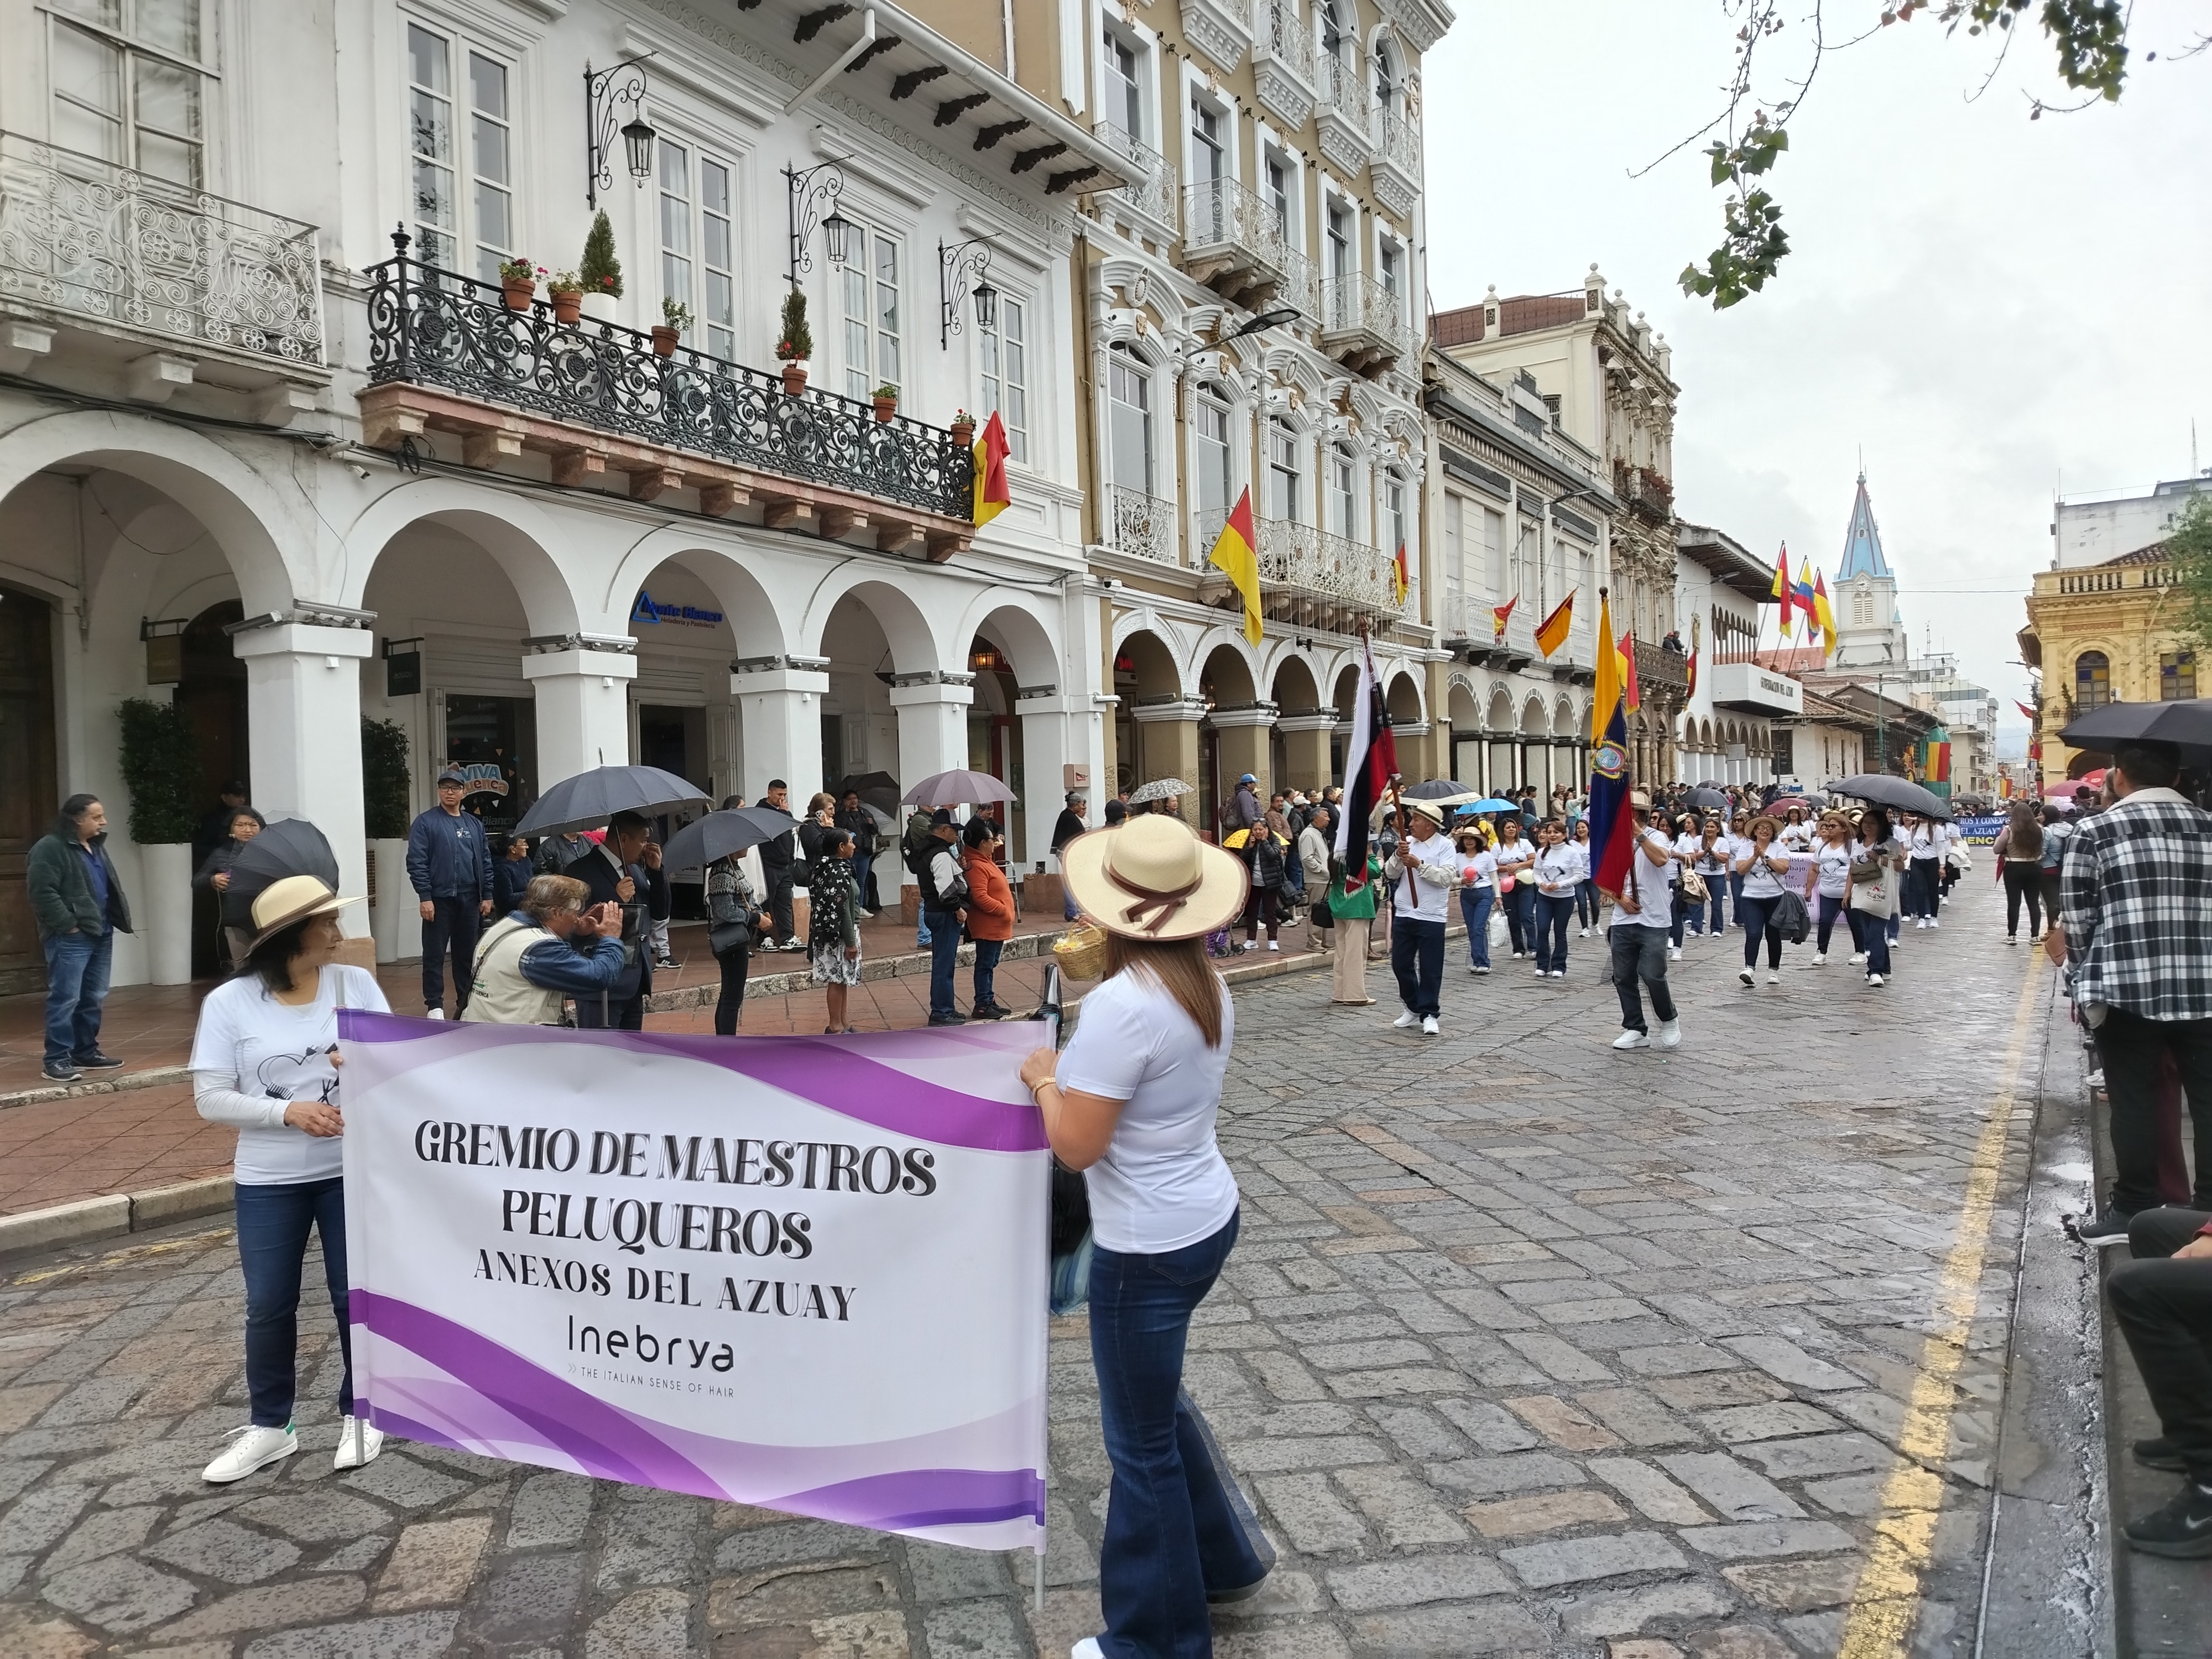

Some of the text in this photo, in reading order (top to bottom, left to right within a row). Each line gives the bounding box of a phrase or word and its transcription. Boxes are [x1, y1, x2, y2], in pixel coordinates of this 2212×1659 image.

[460, 765, 501, 781] VIVA
[463, 779, 508, 795] uenca
[415, 1120, 937, 1197] GREMIO DE MAESTROS
[502, 1189, 813, 1260] PELUQUEROS
[473, 1248, 858, 1321] ANEXOS DEL AZUAY
[568, 1314, 734, 1373] Inebrya
[581, 1366, 734, 1399] THE ITALIAN SENSE OF HAIR
